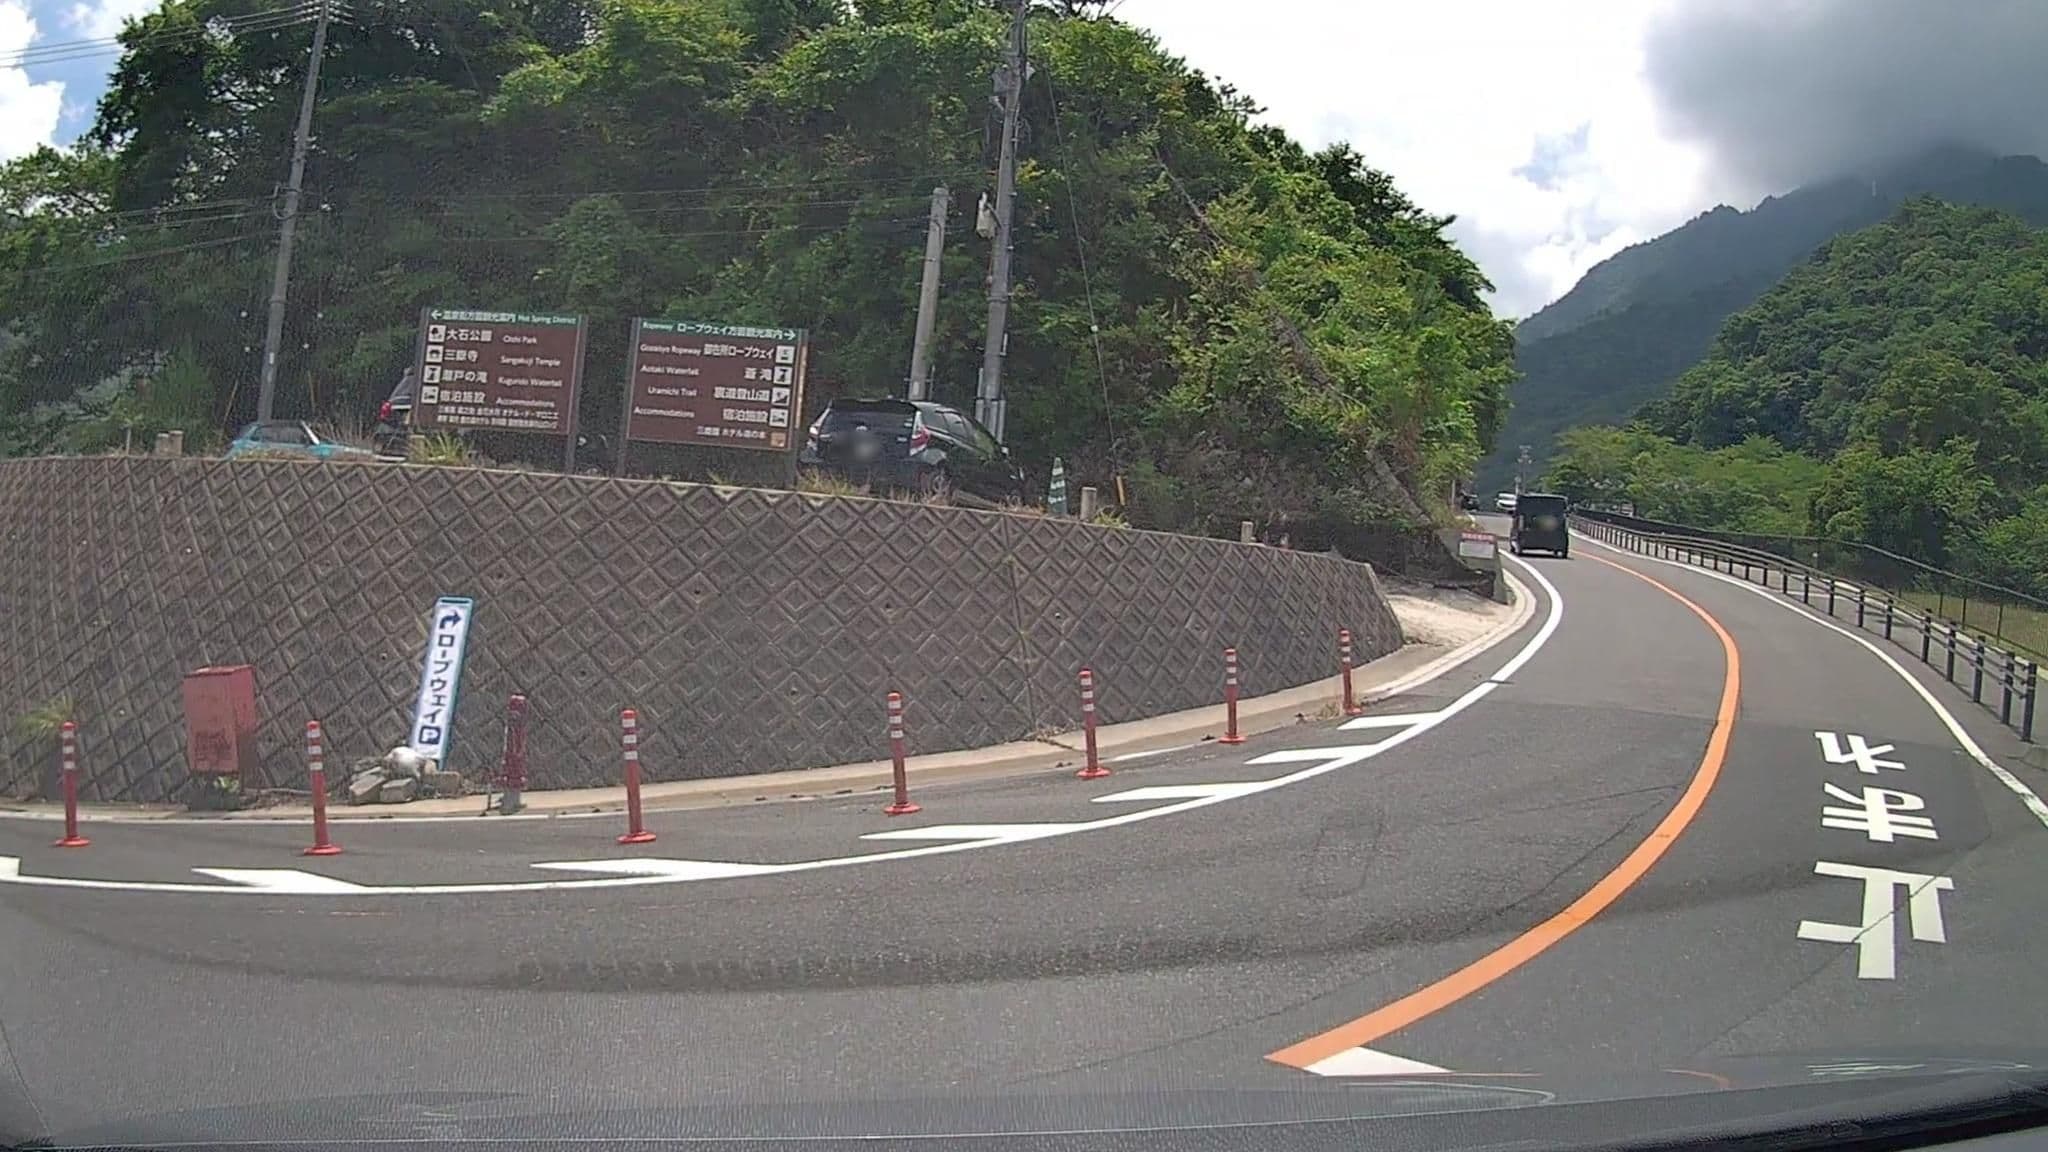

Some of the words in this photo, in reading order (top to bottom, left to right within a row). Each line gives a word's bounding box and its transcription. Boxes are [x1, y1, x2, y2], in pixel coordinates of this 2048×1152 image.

[642, 321, 674, 332] Ropeway
[446, 328, 493, 342] 大石公園
[522, 336, 538, 345] Park
[671, 345, 702, 357] Ropeway
[535, 357, 561, 367] Temple
[640, 364, 665, 375] Aotaki
[666, 366, 700, 377] Waterfall
[647, 386, 679, 396] Uramichi
[680, 387, 698, 397] Trail
[633, 405, 696, 418] Accommodations
[423, 634, 456, 724] ロープウェイ
